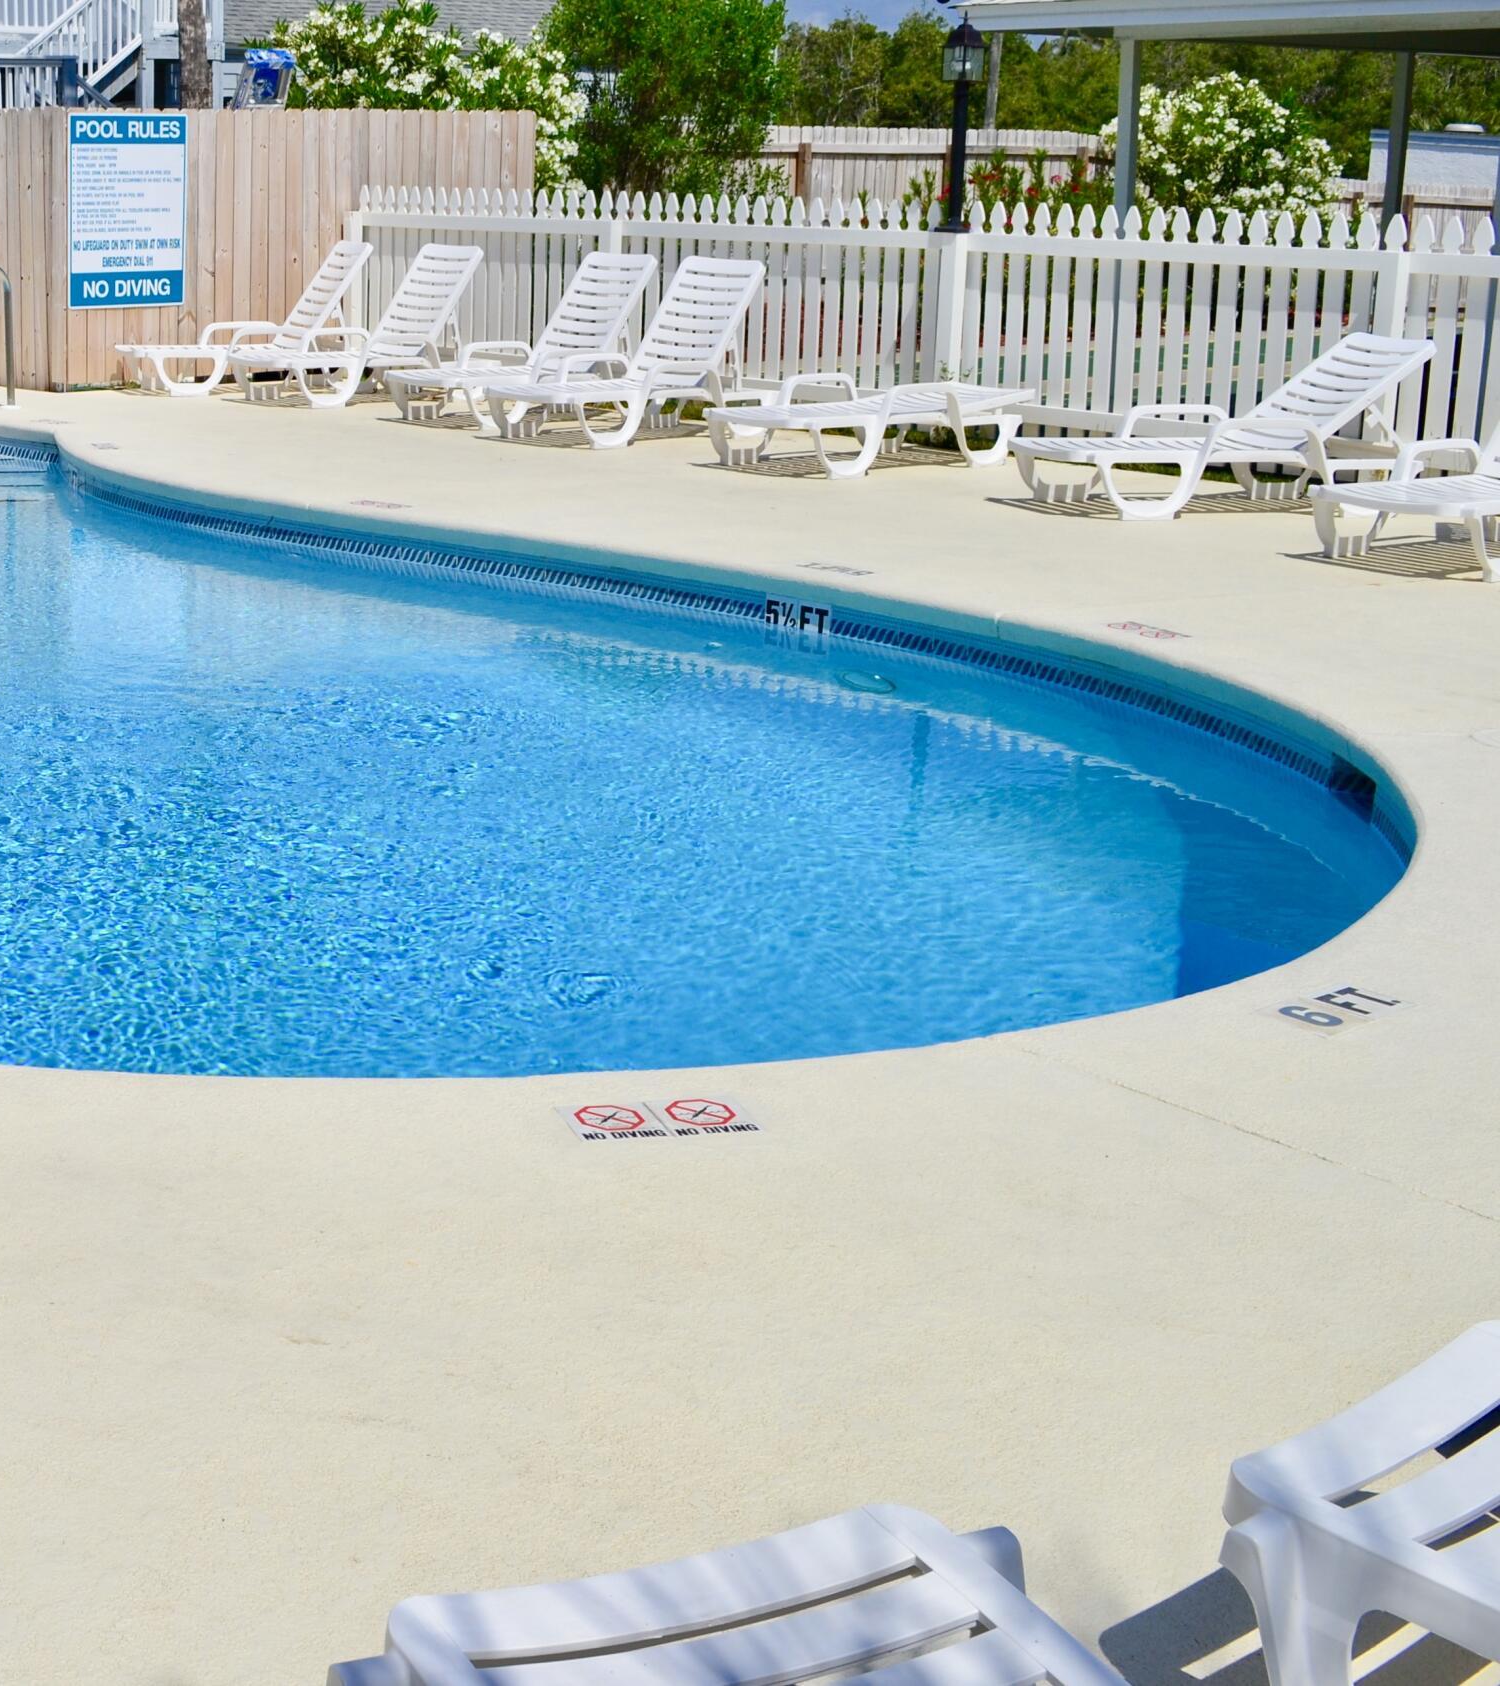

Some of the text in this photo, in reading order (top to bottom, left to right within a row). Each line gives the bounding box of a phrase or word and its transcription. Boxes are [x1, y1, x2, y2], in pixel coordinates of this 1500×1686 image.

[75, 120, 181, 139] POOL RULES
[73, 238, 181, 251] NO LIFEGUARD ON DUTY SWIM AT OWN RISK
[102, 256, 154, 267] EMERGENCY DIAL 911
[83, 278, 171, 299] NO DIVING
[800, 605, 829, 634] FT
[1278, 1005, 1344, 1027] 6
[582, 1129, 668, 1141] NO DIVING
[675, 1123, 761, 1137] NO DIVING
